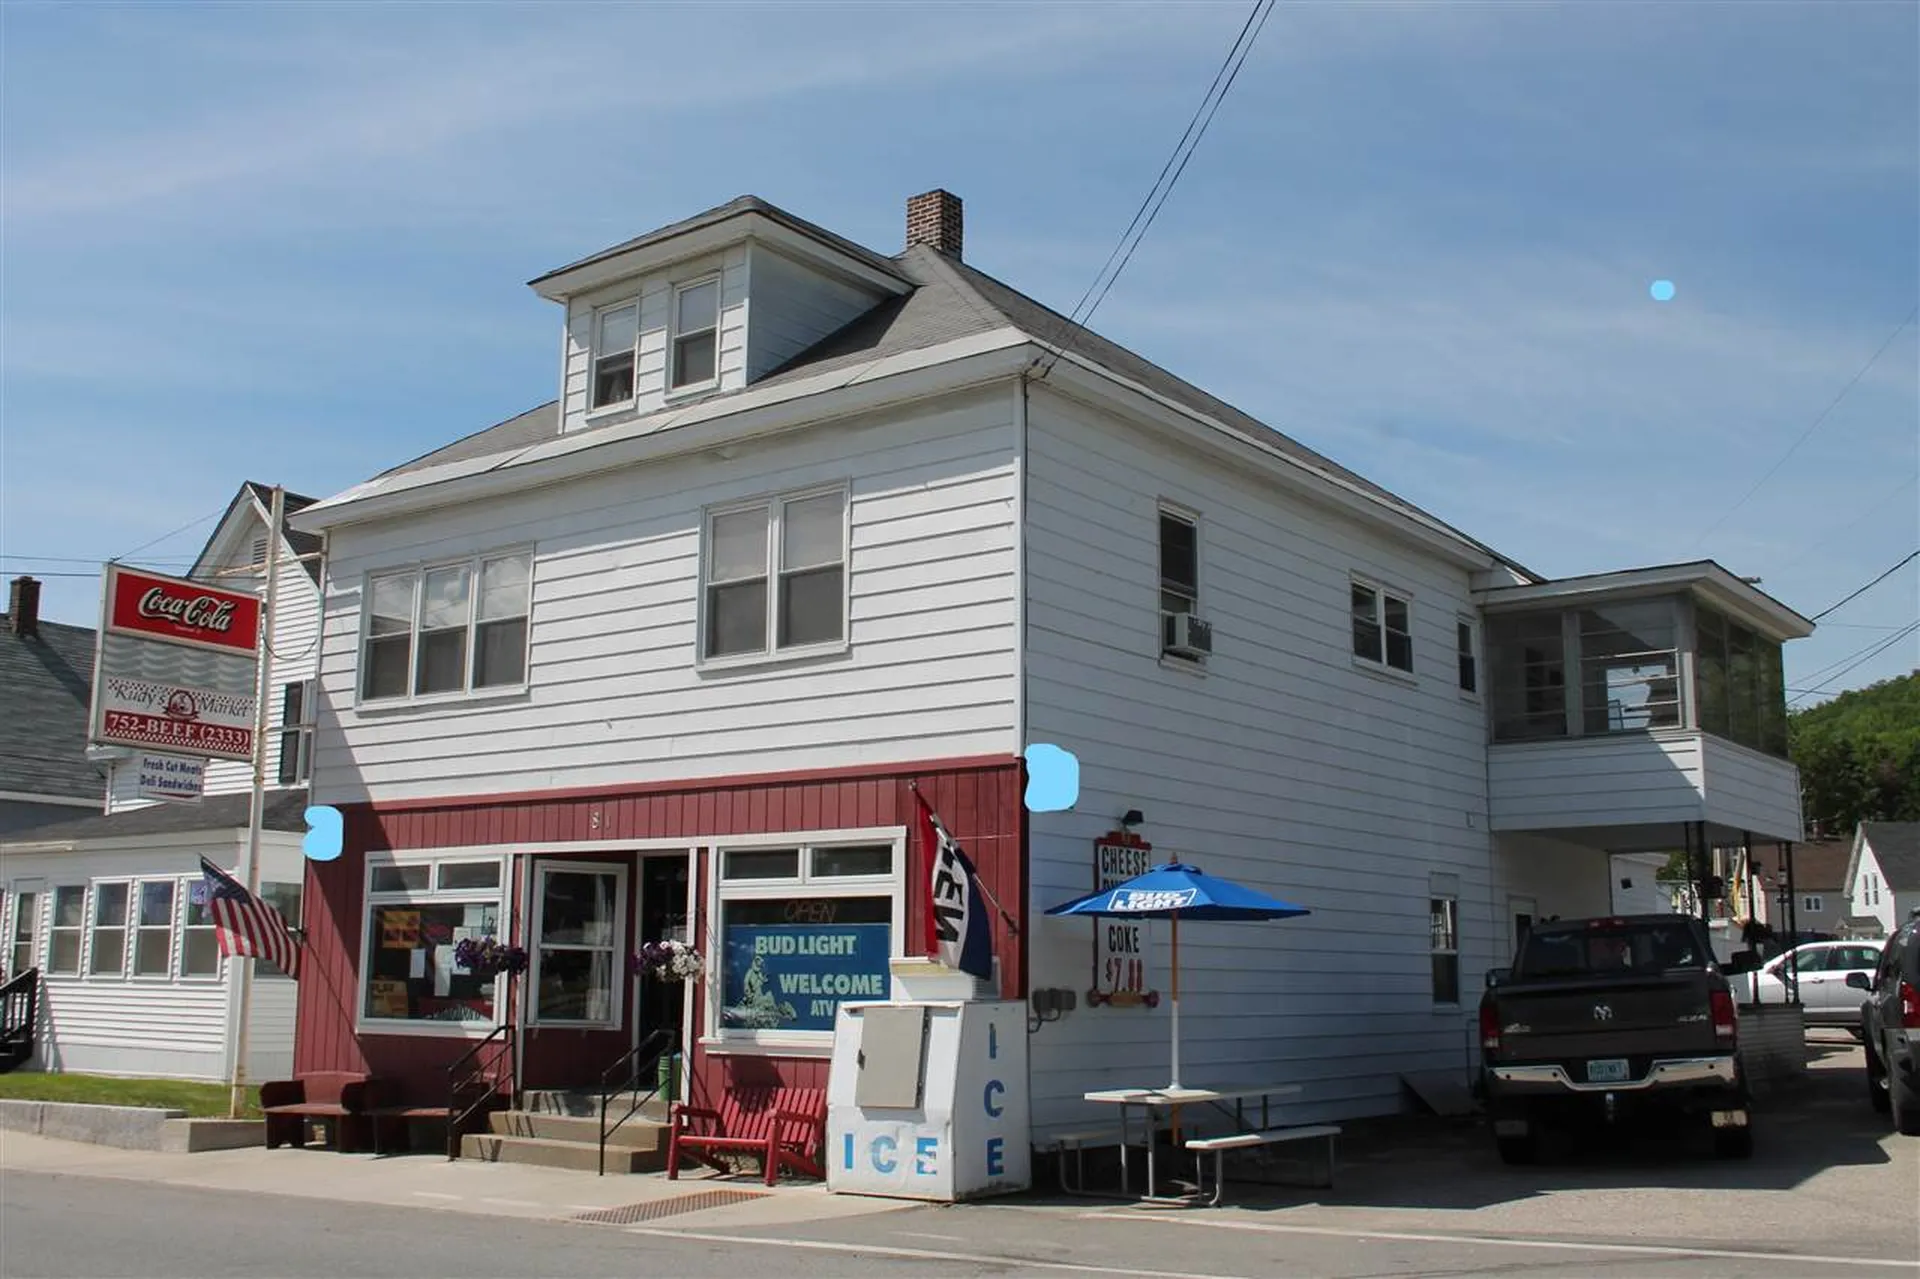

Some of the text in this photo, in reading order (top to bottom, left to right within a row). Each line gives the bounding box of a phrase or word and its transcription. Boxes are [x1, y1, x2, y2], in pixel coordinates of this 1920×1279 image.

[115, 684, 249, 718] Rudy's Market
[110, 714, 249, 746] 752-BEEF (2333)
[1102, 847, 1147, 877] CHEESE
[783, 901, 837, 922] OPEN
[755, 935, 857, 955] BUD LIGHT
[1108, 924, 1140, 953] COKE
[779, 974, 884, 996] WELCOME
[983, 1022, 1005, 1177] ICE
[843, 1133, 939, 1175] ICE
